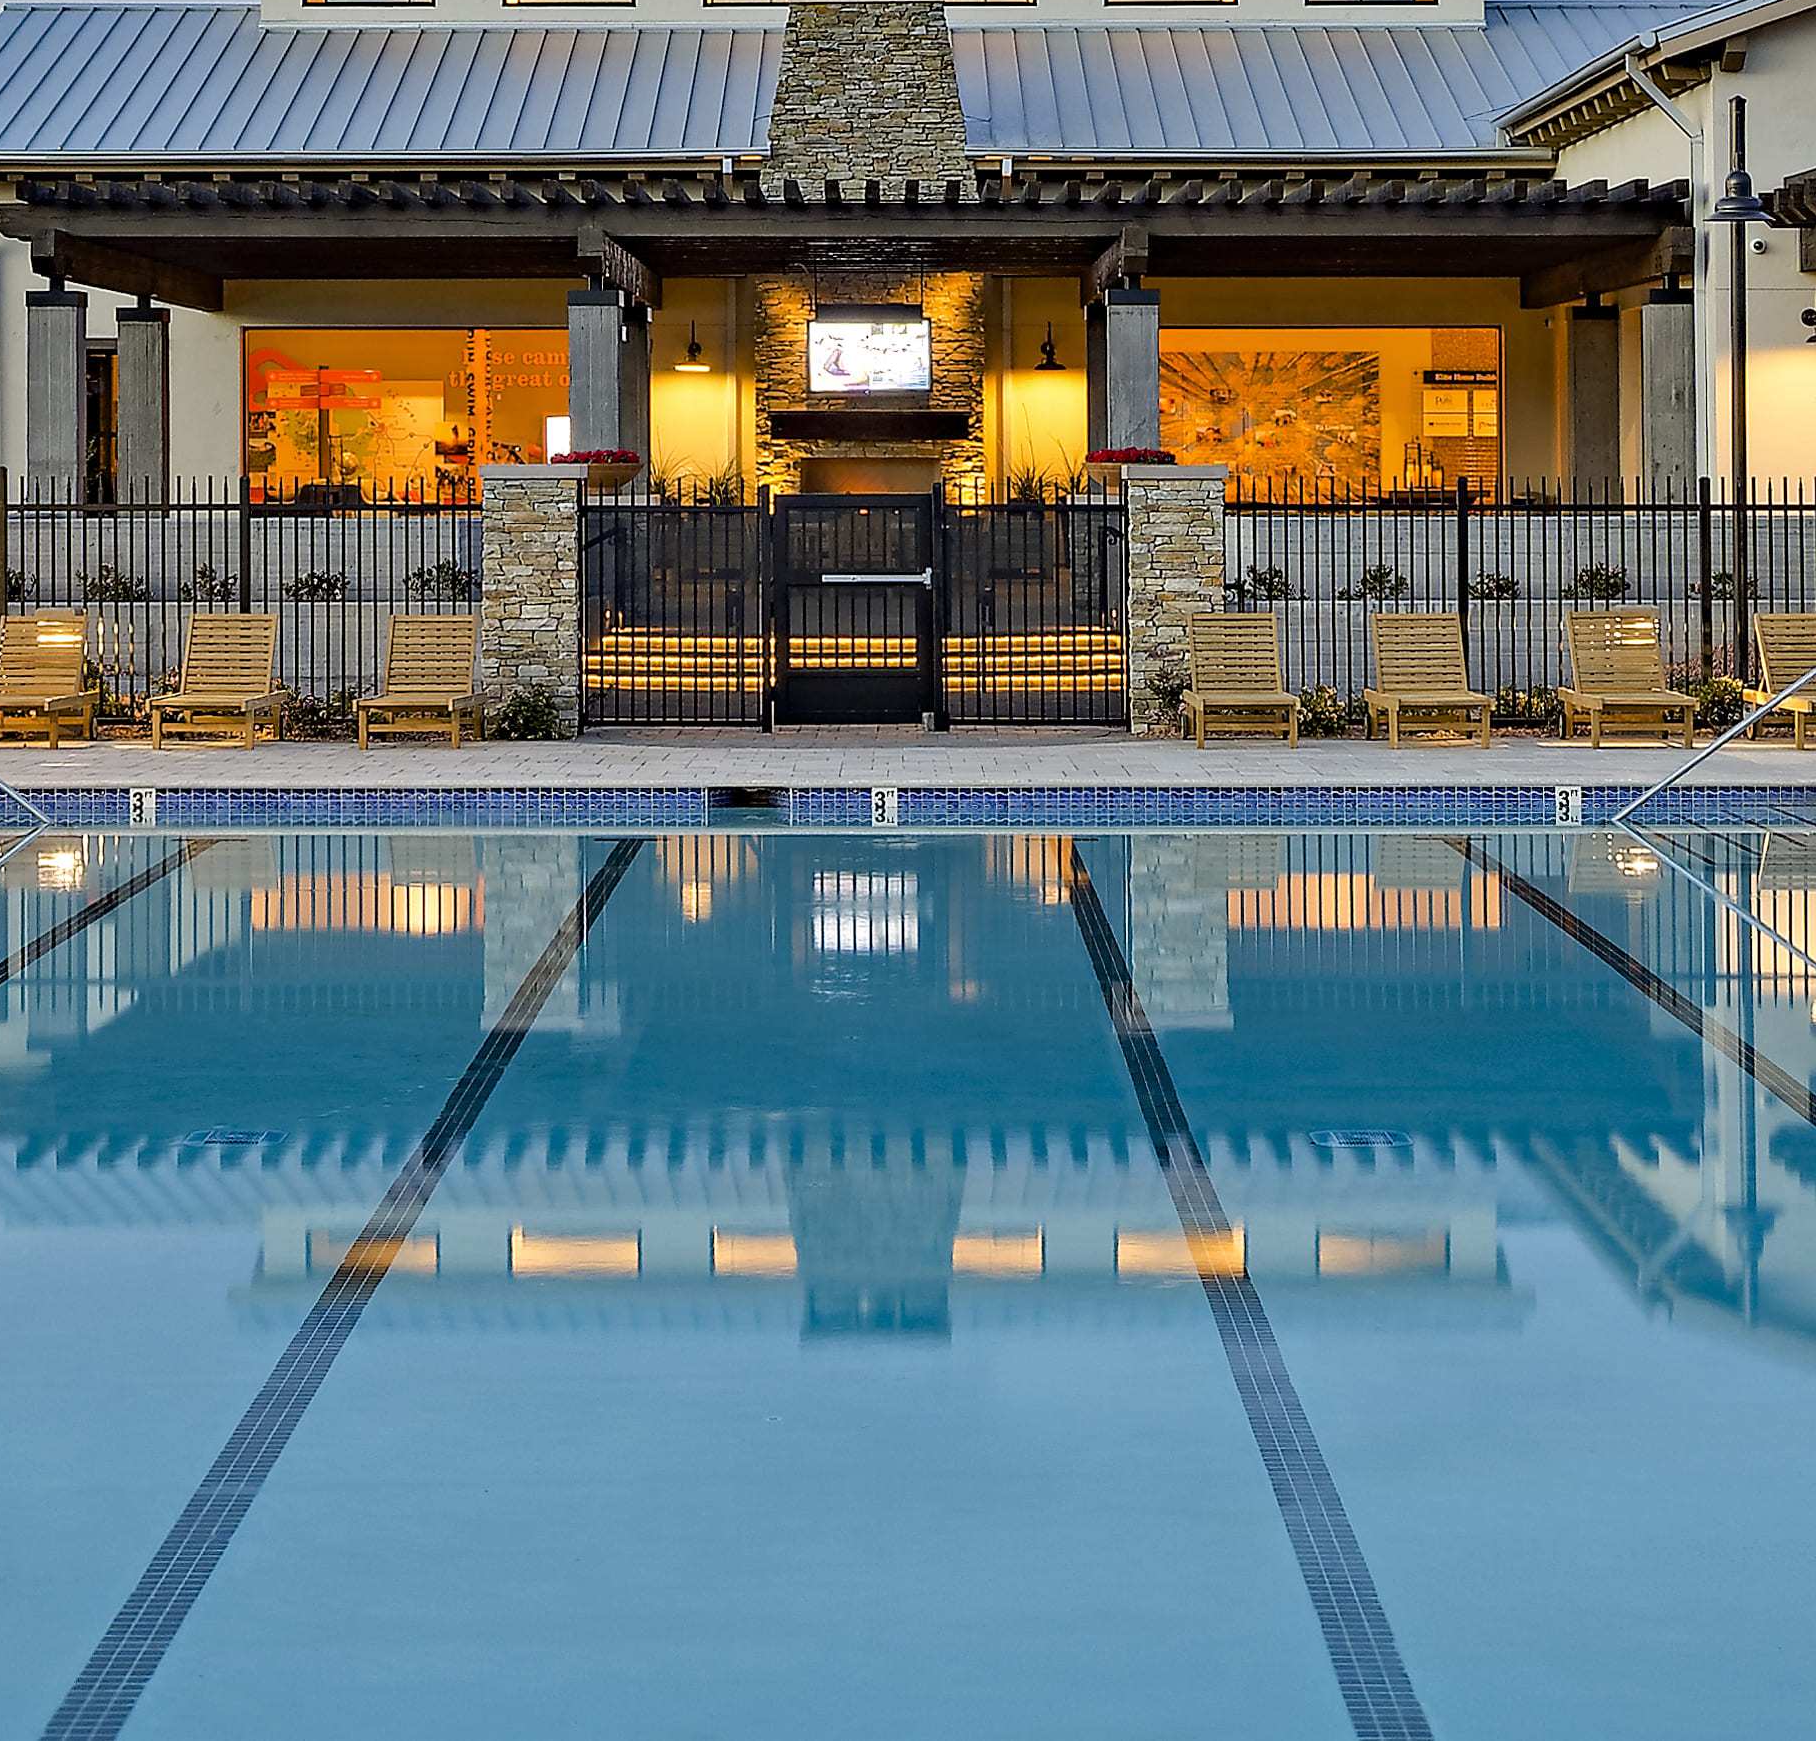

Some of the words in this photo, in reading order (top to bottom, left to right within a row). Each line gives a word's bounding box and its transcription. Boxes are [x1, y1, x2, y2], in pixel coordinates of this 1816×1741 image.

[492, 370, 552, 391] great
[467, 373, 475, 416] SWIM
[875, 791, 886, 807] 3
